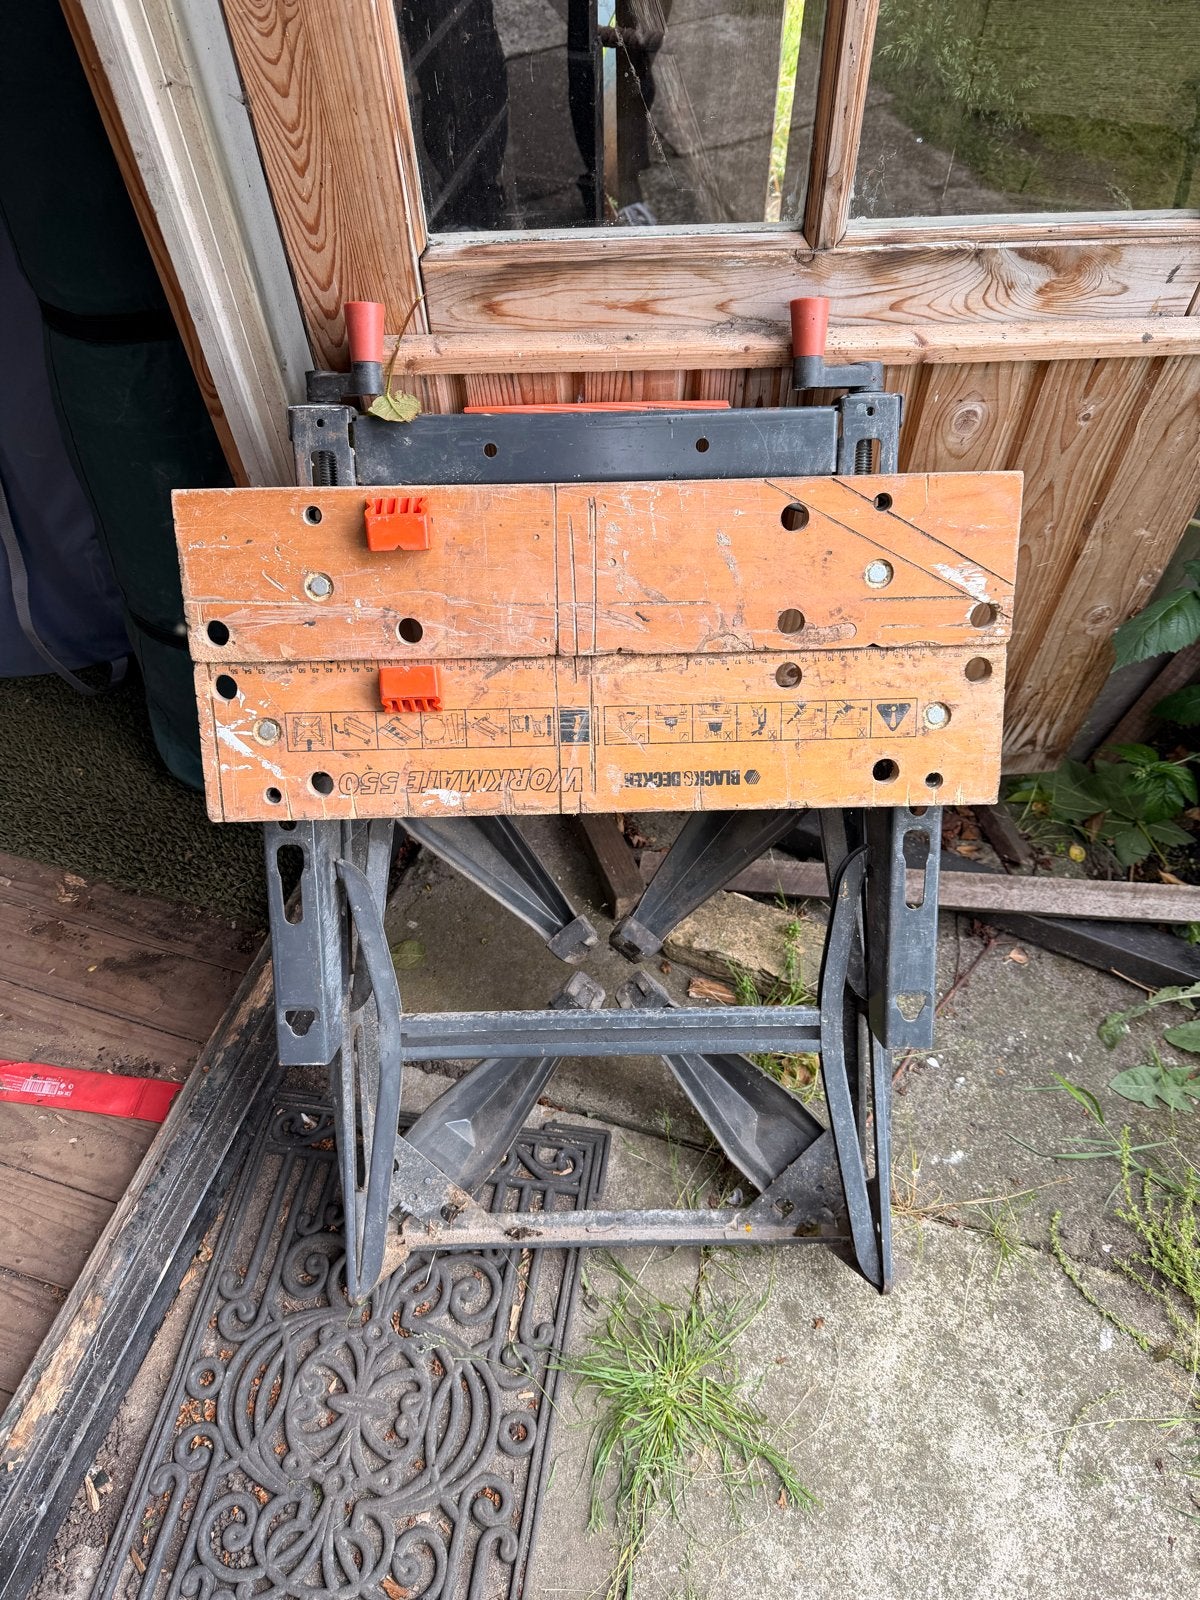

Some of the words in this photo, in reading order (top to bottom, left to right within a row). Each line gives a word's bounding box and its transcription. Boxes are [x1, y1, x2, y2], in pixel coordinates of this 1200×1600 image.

[338, 771, 400, 795] 550
[406, 767, 583, 794] WORKMATE
[623, 769, 741, 788] BLACK&DECKER
